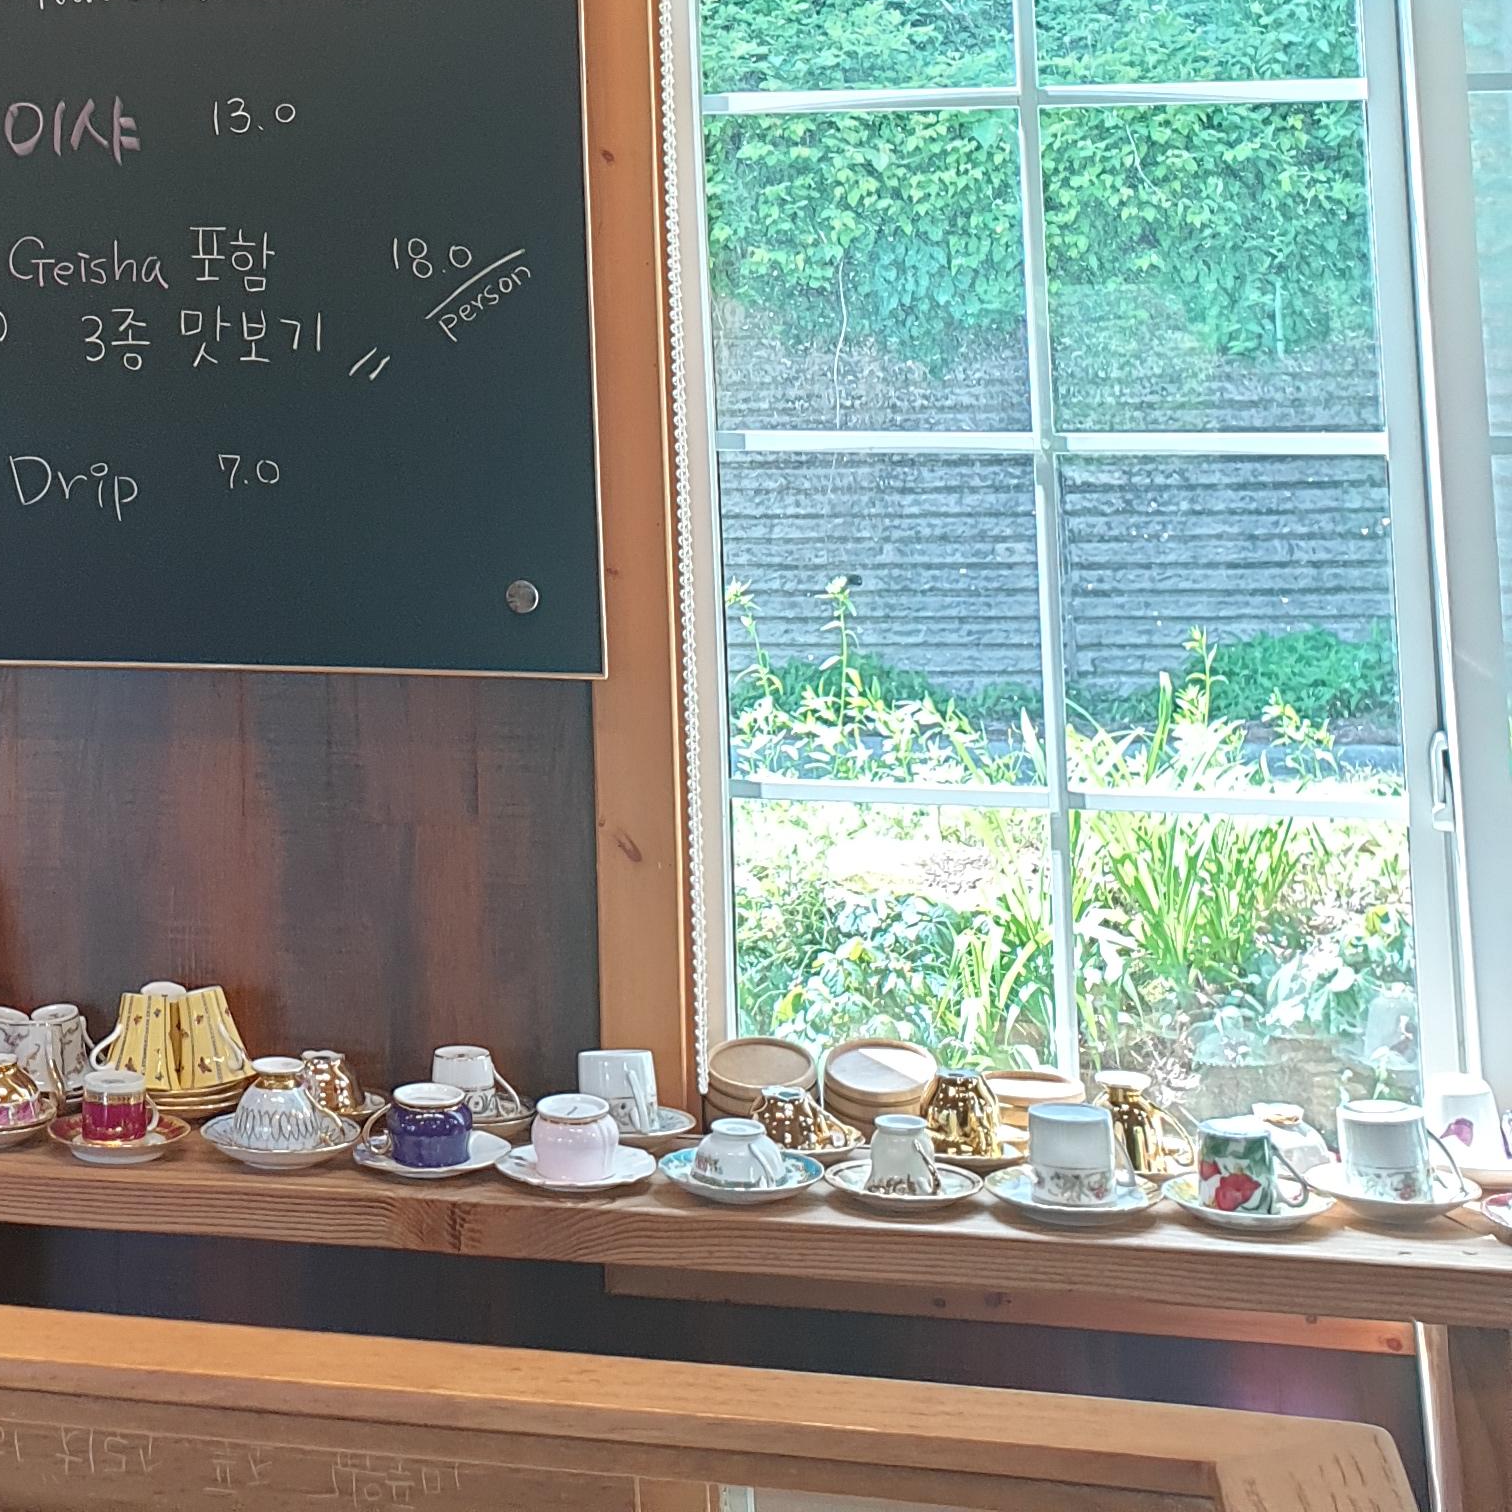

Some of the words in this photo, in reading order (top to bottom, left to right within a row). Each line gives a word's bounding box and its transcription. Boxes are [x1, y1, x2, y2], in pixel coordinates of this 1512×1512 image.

[214, 98, 296, 136] 13.0
[190, 227, 276, 291] 포함
[392, 237, 473, 279] 18.0
[82, 308, 151, 370] 3종
[9, 454, 139, 521] Drip
[218, 454, 281, 489] 7.0
